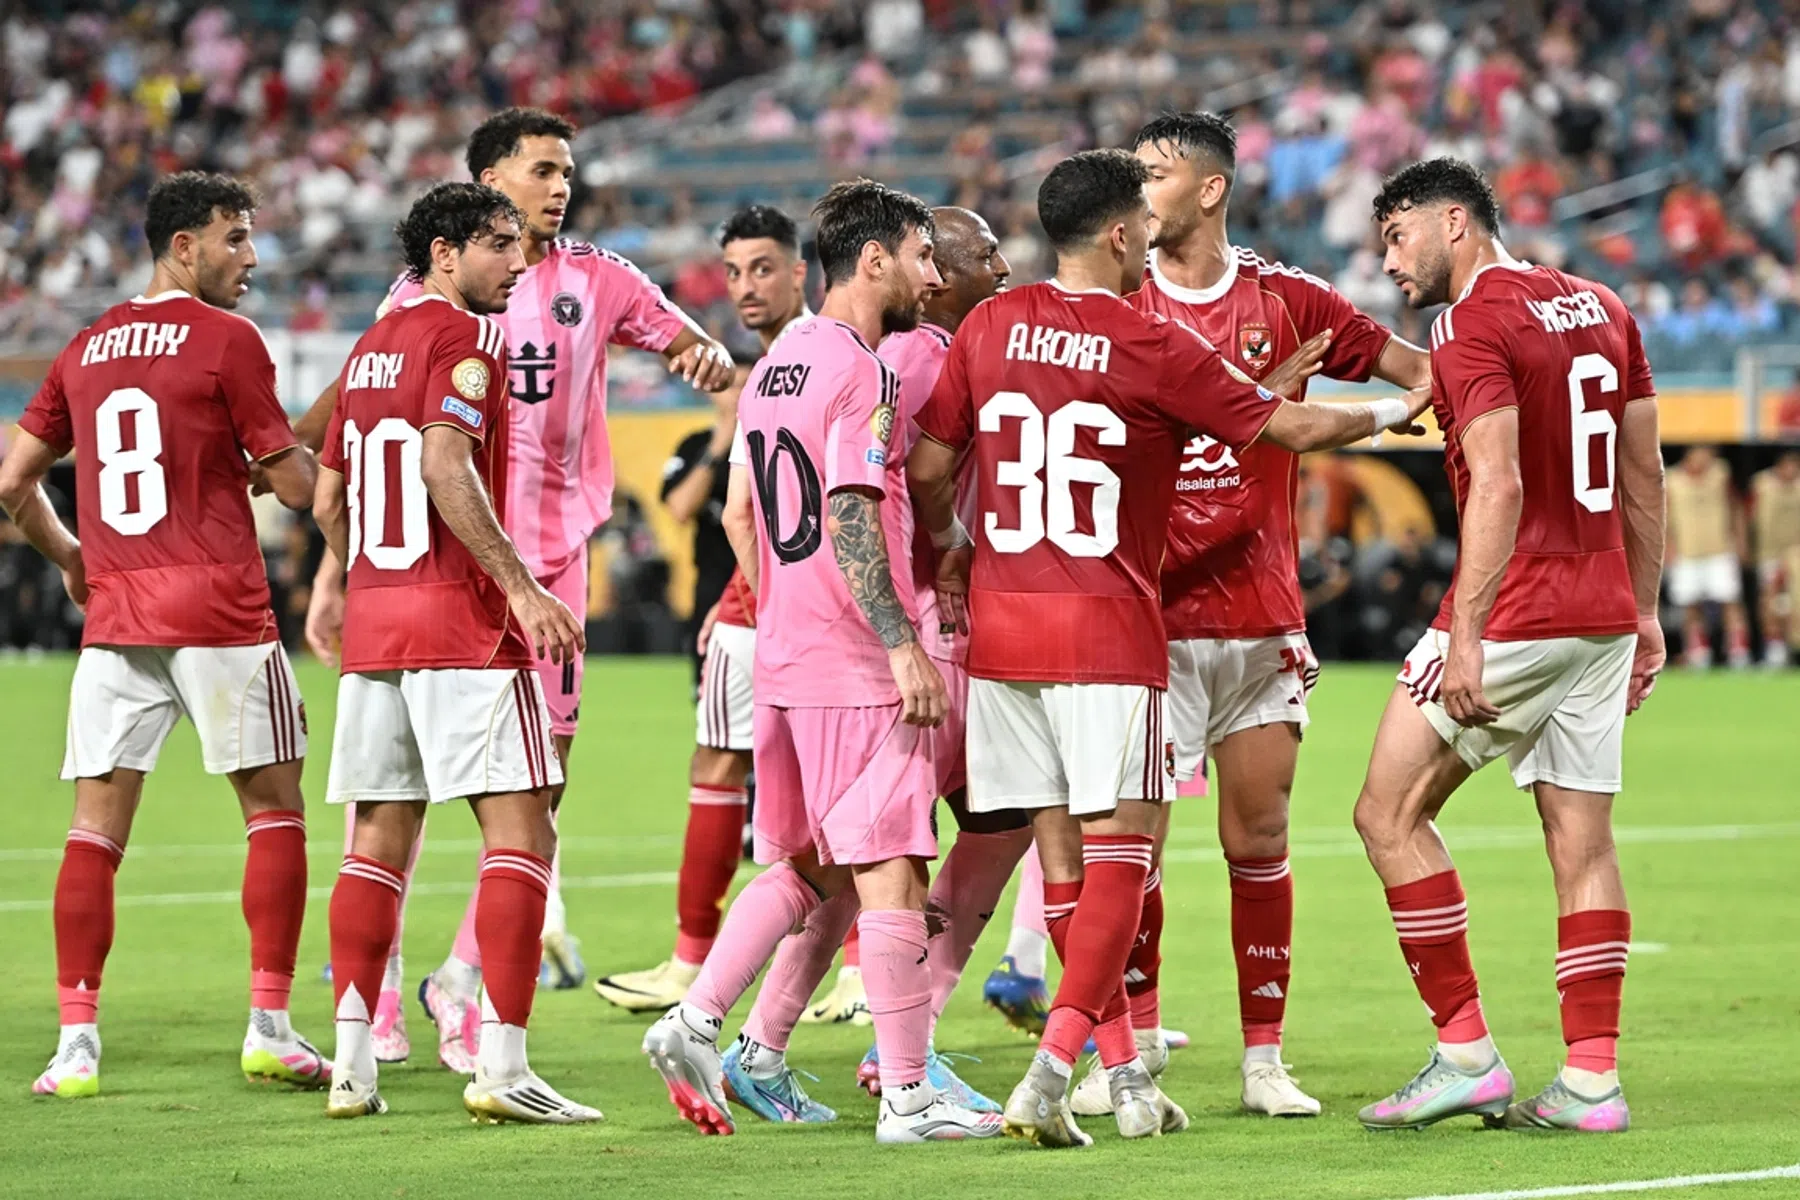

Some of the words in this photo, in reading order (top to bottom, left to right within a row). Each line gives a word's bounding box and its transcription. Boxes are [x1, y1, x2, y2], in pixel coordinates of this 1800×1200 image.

[80, 321, 190, 367] H.FATHY
[1005, 322, 1112, 374] A.KOKA
[95, 387, 168, 536] 8
[978, 390, 1127, 559] 36
[1567, 352, 1619, 513] 6
[746, 426, 822, 566] 10
[1175, 476, 1216, 491] tisalat
[1216, 473, 1241, 488] and
[1246, 944, 1290, 960] AHLY
